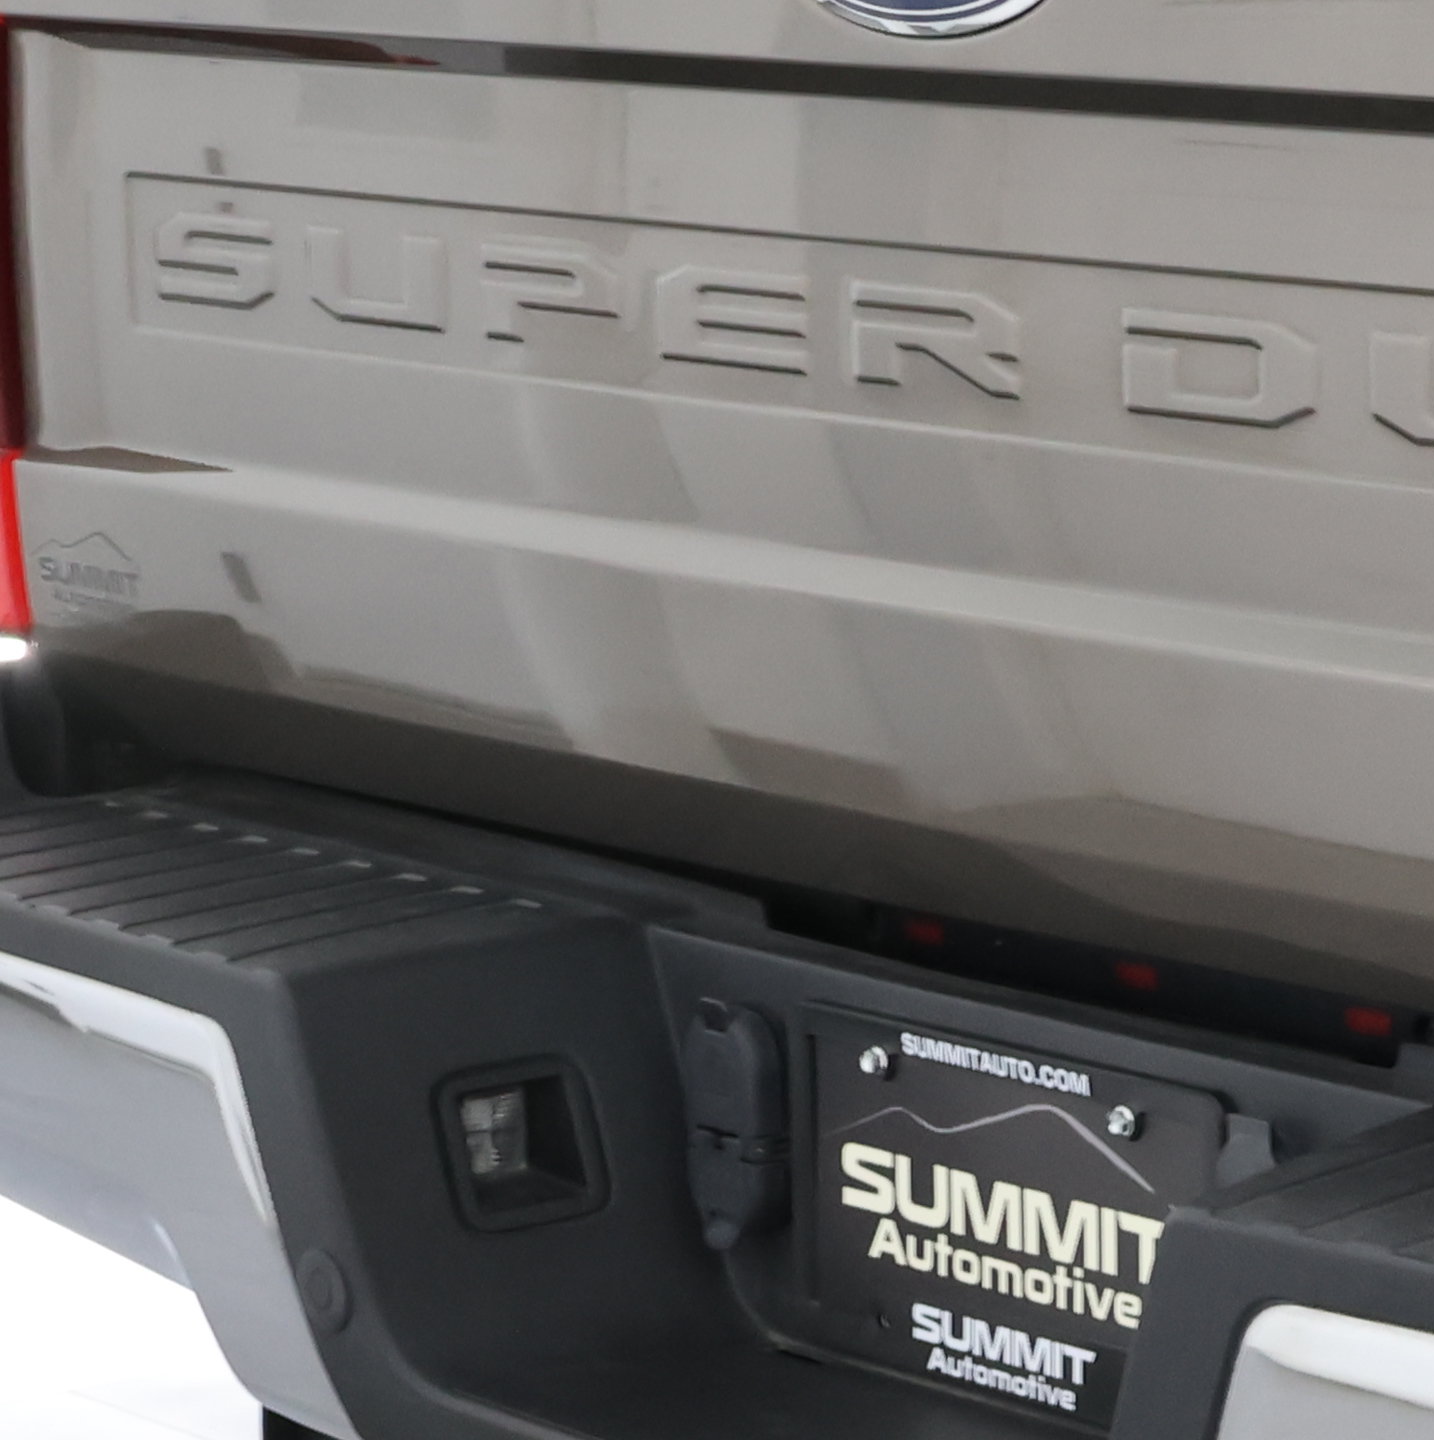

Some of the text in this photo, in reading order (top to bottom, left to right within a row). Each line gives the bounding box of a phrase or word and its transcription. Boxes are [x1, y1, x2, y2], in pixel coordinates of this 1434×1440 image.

[152, 209, 1023, 401] SUPER
[900, 1032, 1092, 1097] SUMMITAUTO.COM
[840, 1141, 1165, 1285] SUMMIT
[867, 1217, 1143, 1330] Automotive
[911, 1302, 1097, 1386] SUMMIT
[926, 1346, 1077, 1411] Automotive
